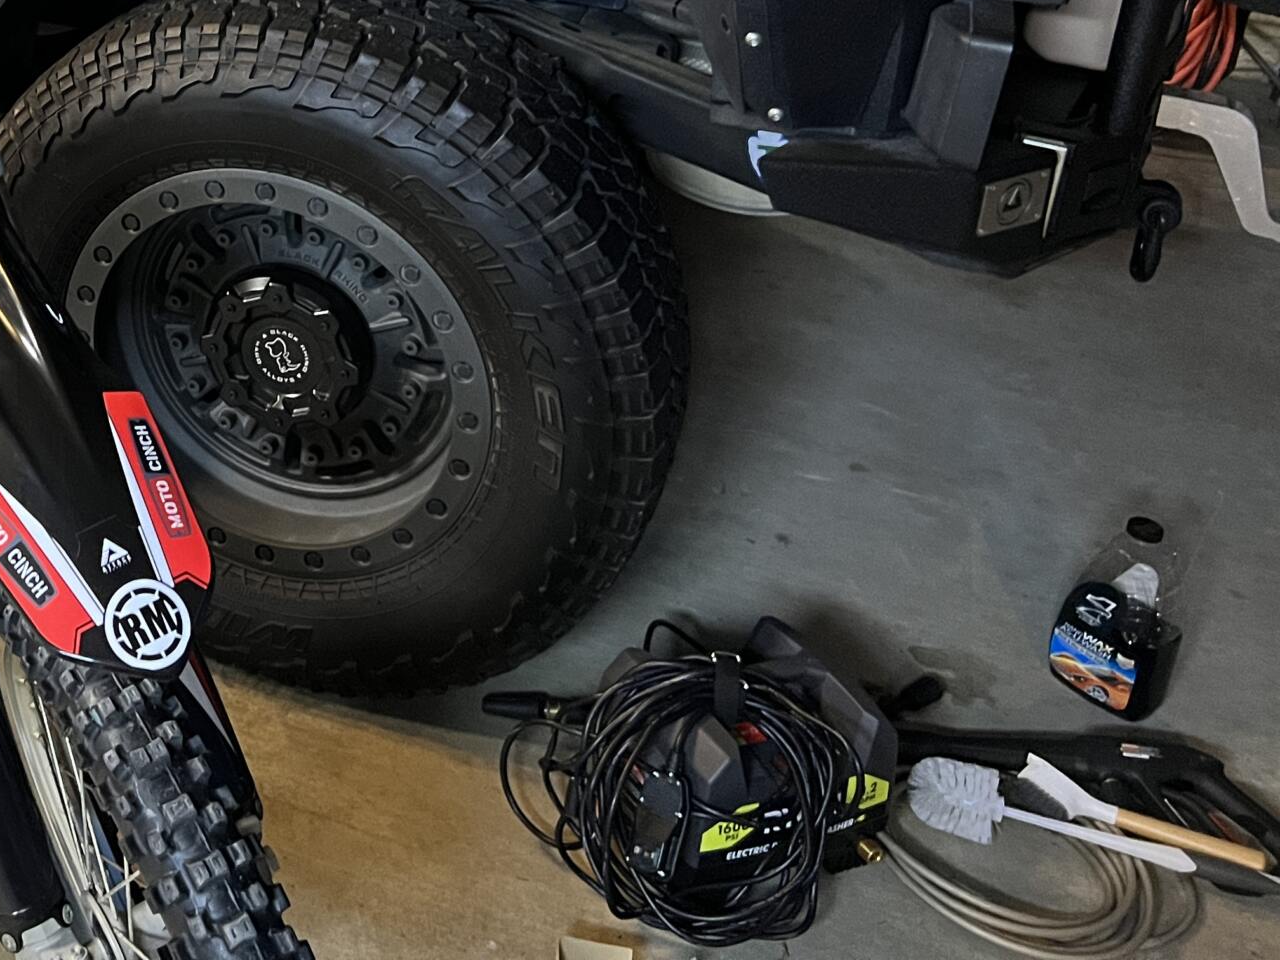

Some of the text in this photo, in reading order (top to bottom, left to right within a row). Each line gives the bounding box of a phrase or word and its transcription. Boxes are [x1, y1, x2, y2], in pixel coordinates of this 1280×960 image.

[134, 424, 184, 530] MOTO CINCH
[6, 548, 49, 600] CINCH
[120, 598, 176, 651] RM
[826, 817, 854, 834] ASHER
[726, 844, 769, 861] ELECTRIC
